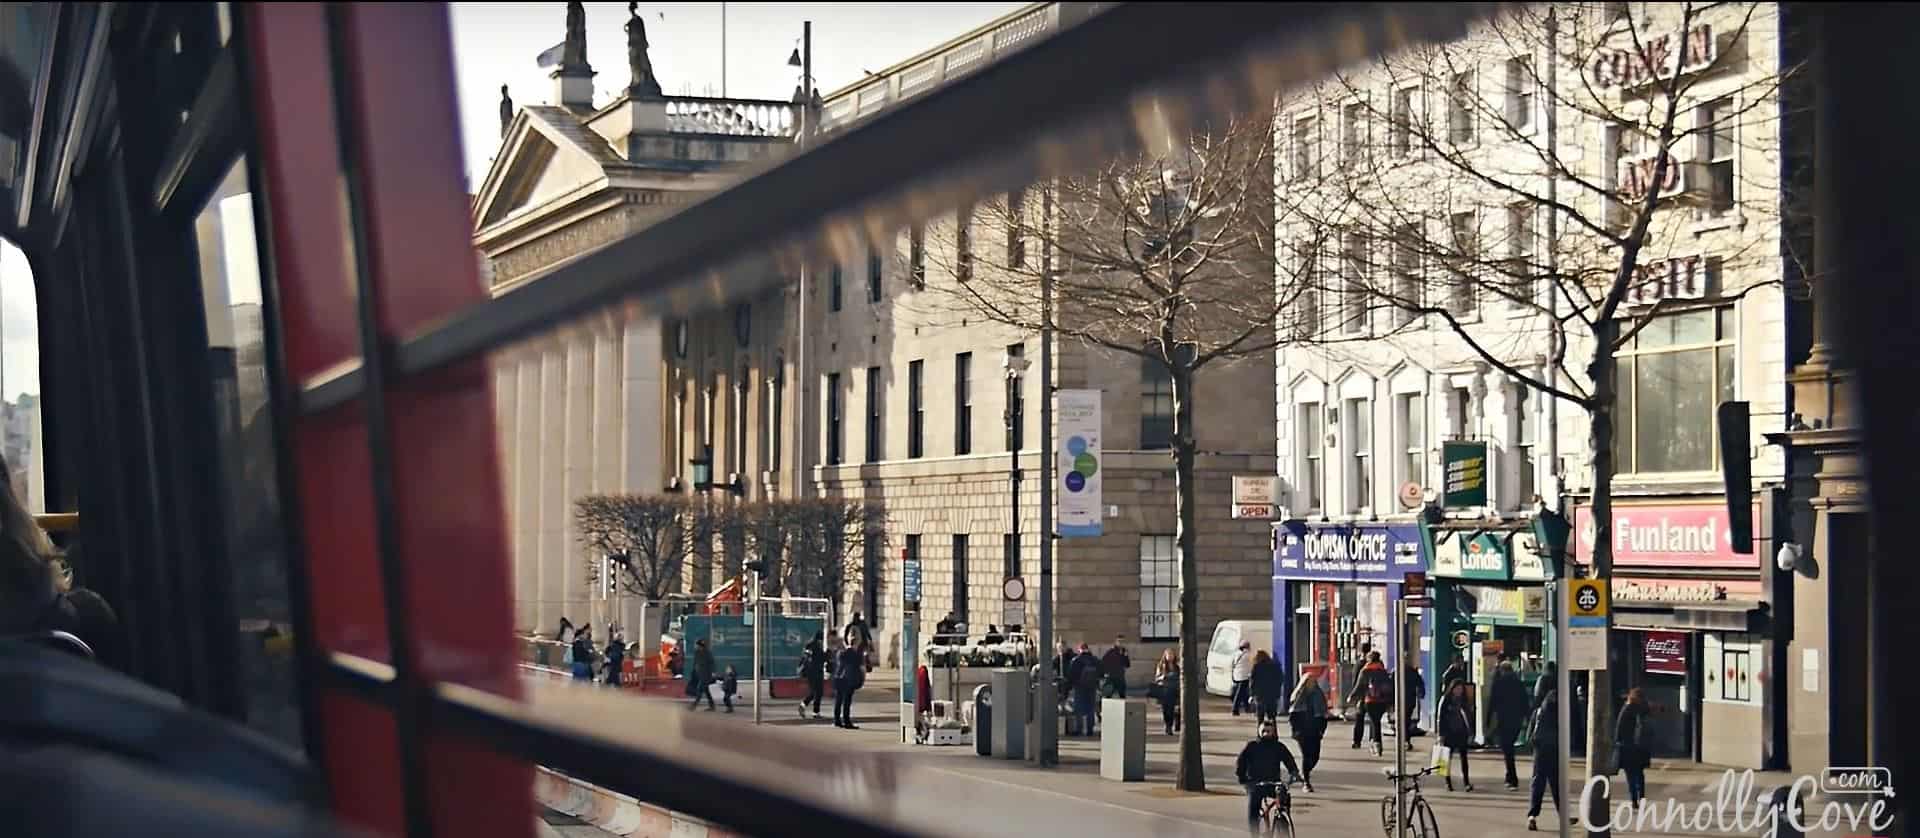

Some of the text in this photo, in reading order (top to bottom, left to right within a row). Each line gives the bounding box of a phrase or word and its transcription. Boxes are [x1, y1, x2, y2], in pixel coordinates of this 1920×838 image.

[1447, 457, 1484, 472] SUBWAY
[1447, 468, 1484, 482] SUBWAY
[1447, 478, 1484, 493] SUBWAY
[1241, 507, 1269, 516] OPEN
[1615, 516, 1716, 552] Funland
[1303, 533, 1347, 561] TOURISM
[1349, 533, 1386, 561] OFFICE
